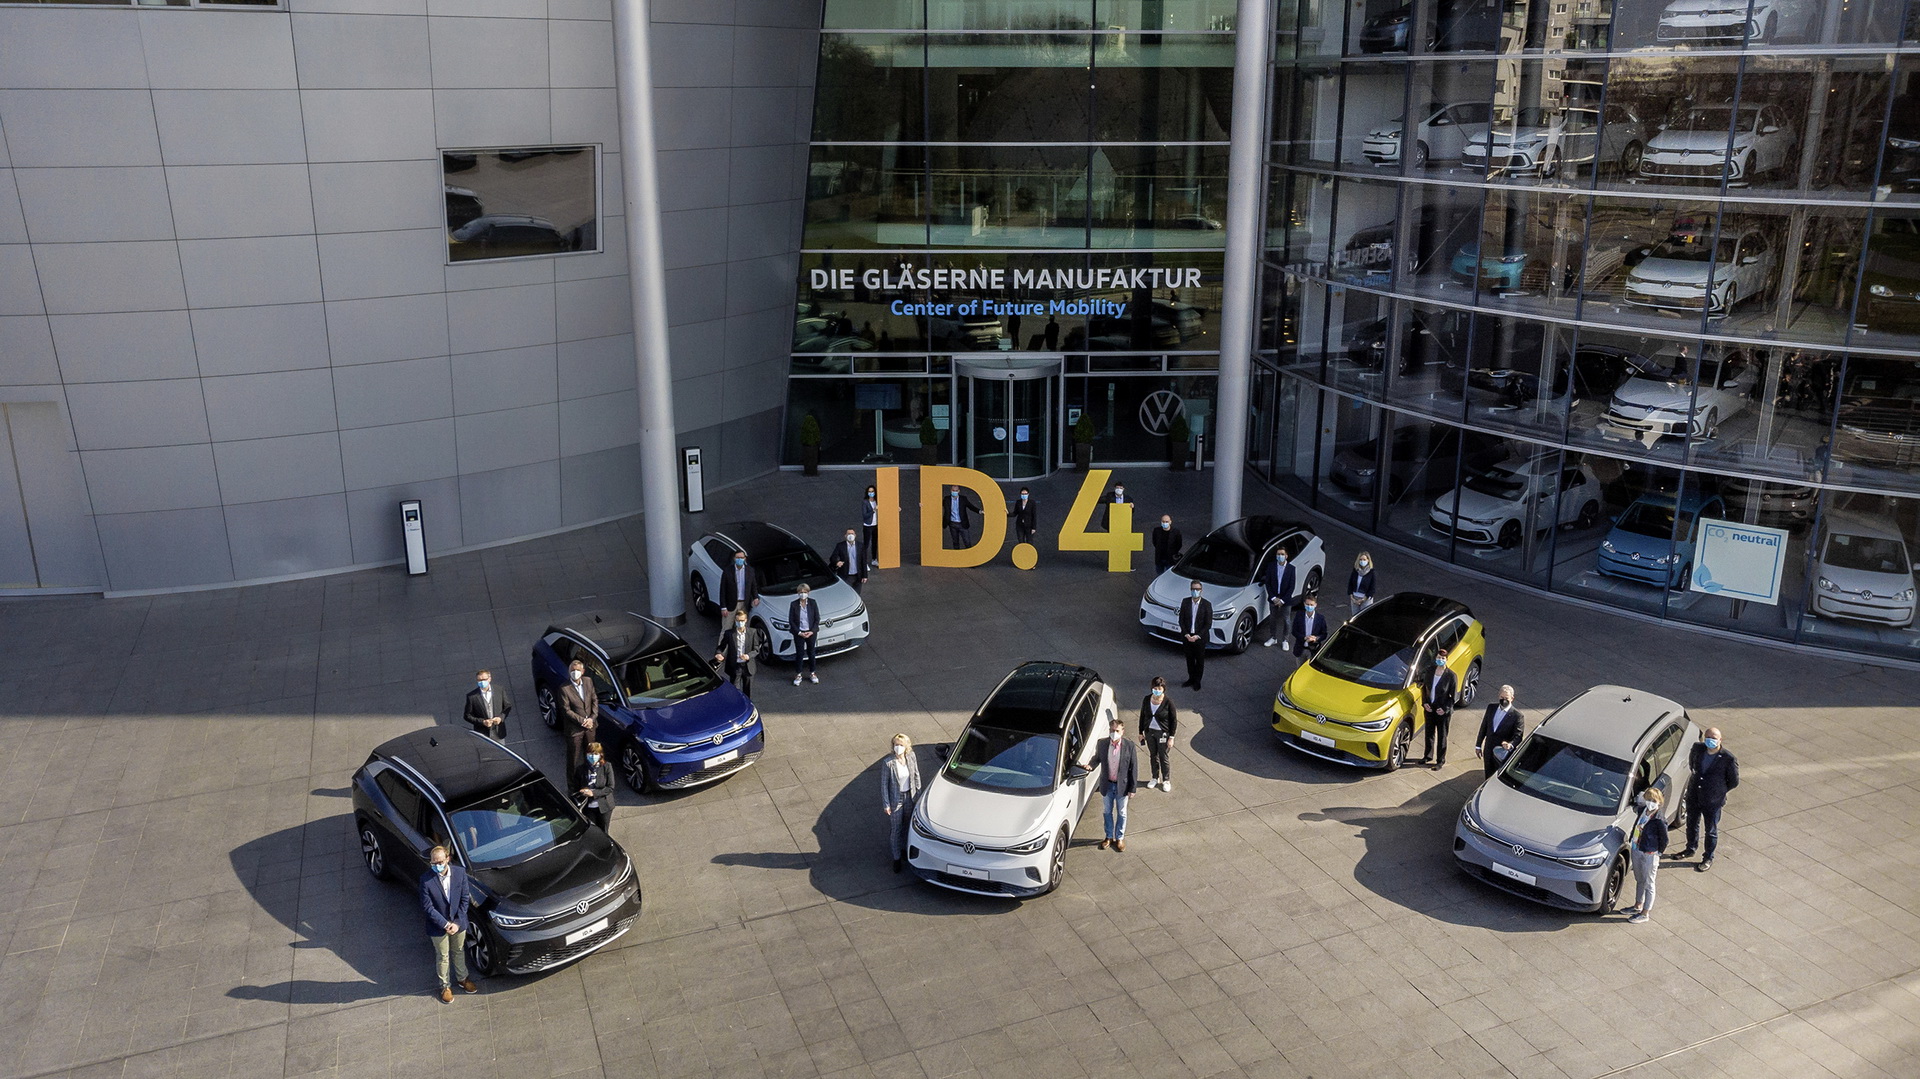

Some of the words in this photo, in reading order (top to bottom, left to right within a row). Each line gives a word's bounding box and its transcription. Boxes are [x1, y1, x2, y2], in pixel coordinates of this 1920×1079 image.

[811, 269, 855, 290] DIE
[862, 263, 1005, 290] GLÄSERNE
[1013, 268, 1202, 290] MANUFAKTUR
[890, 300, 953, 316] Center
[958, 299, 978, 316] of
[982, 300, 1044, 316] Future
[1049, 298, 1127, 319] Mobility
[876, 465, 1144, 573] ID.4
[1732, 532, 1777, 547] neutral
